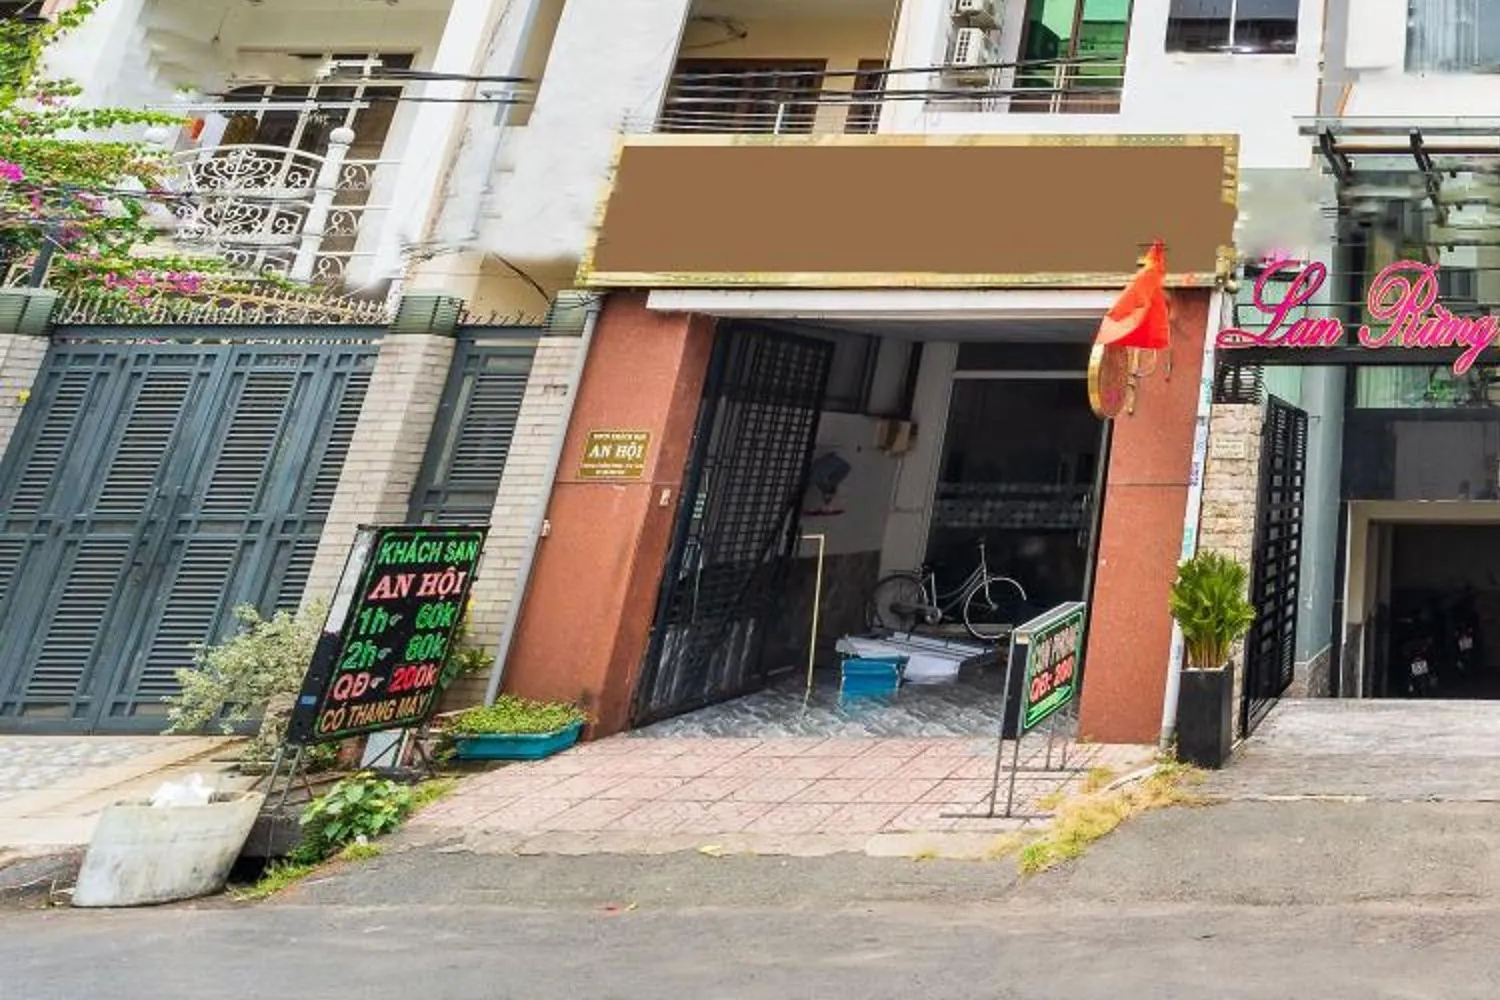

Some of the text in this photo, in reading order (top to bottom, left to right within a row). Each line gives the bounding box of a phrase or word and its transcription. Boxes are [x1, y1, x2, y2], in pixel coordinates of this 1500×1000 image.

[1215, 259, 1344, 350] Lan
[1358, 259, 1500, 376] Rừng
[588, 441, 645, 461] AN HỘI
[378, 538, 479, 566] KHÁCH SẠN
[368, 566, 467, 602] AN HỘI
[358, 605, 389, 635] 1h
[340, 640, 378, 669] 2h
[333, 672, 371, 701] QĐ
[321, 690, 430, 732] CÓ THANG MÁY
